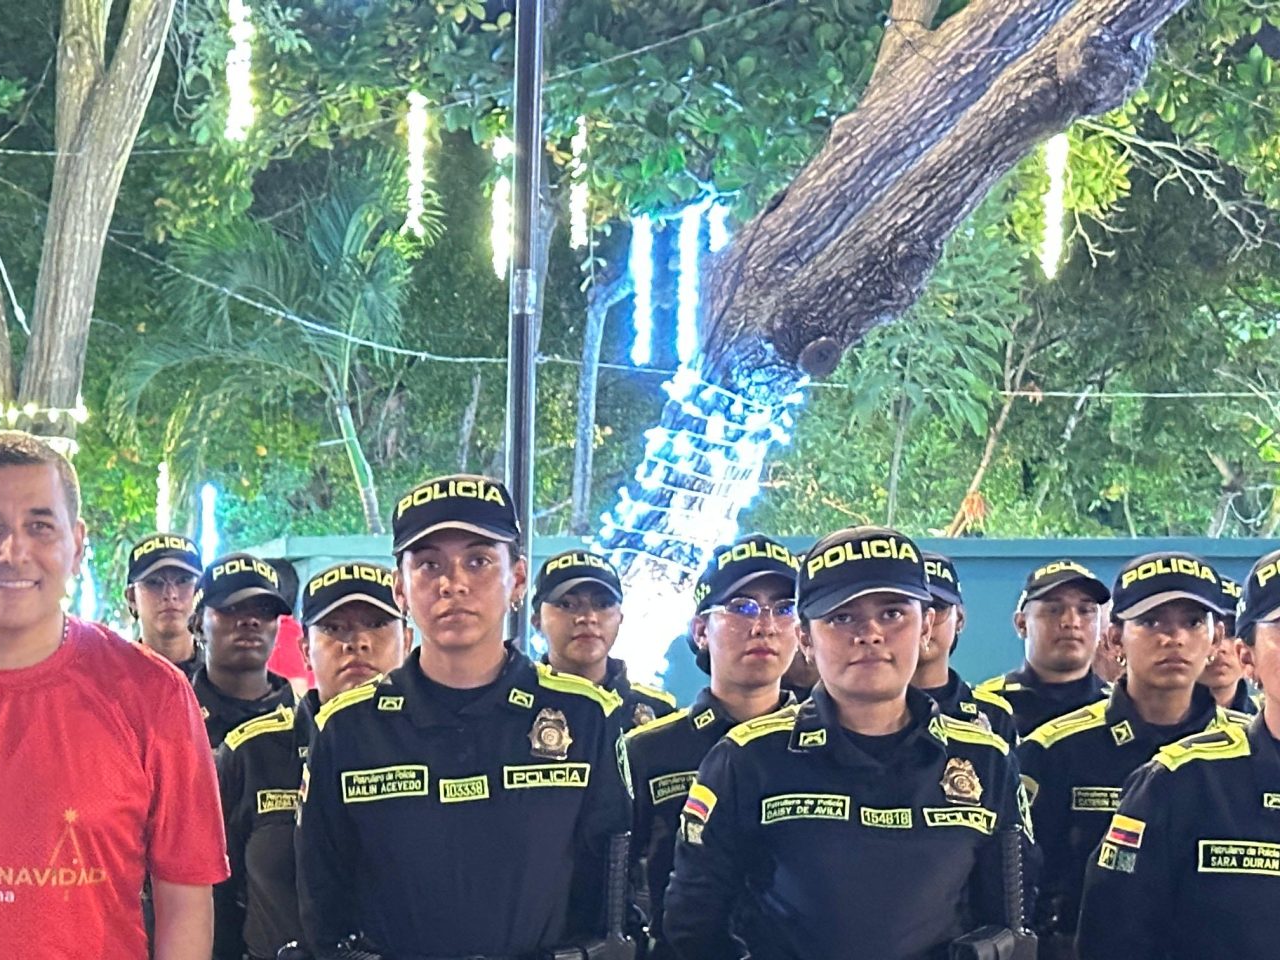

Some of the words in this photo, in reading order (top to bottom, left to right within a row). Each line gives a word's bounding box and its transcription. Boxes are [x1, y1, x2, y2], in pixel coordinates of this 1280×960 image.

[381, 780, 422, 793] ACEVEDO
[796, 806, 809, 814] DE
[1211, 856, 1238, 867] SARA
